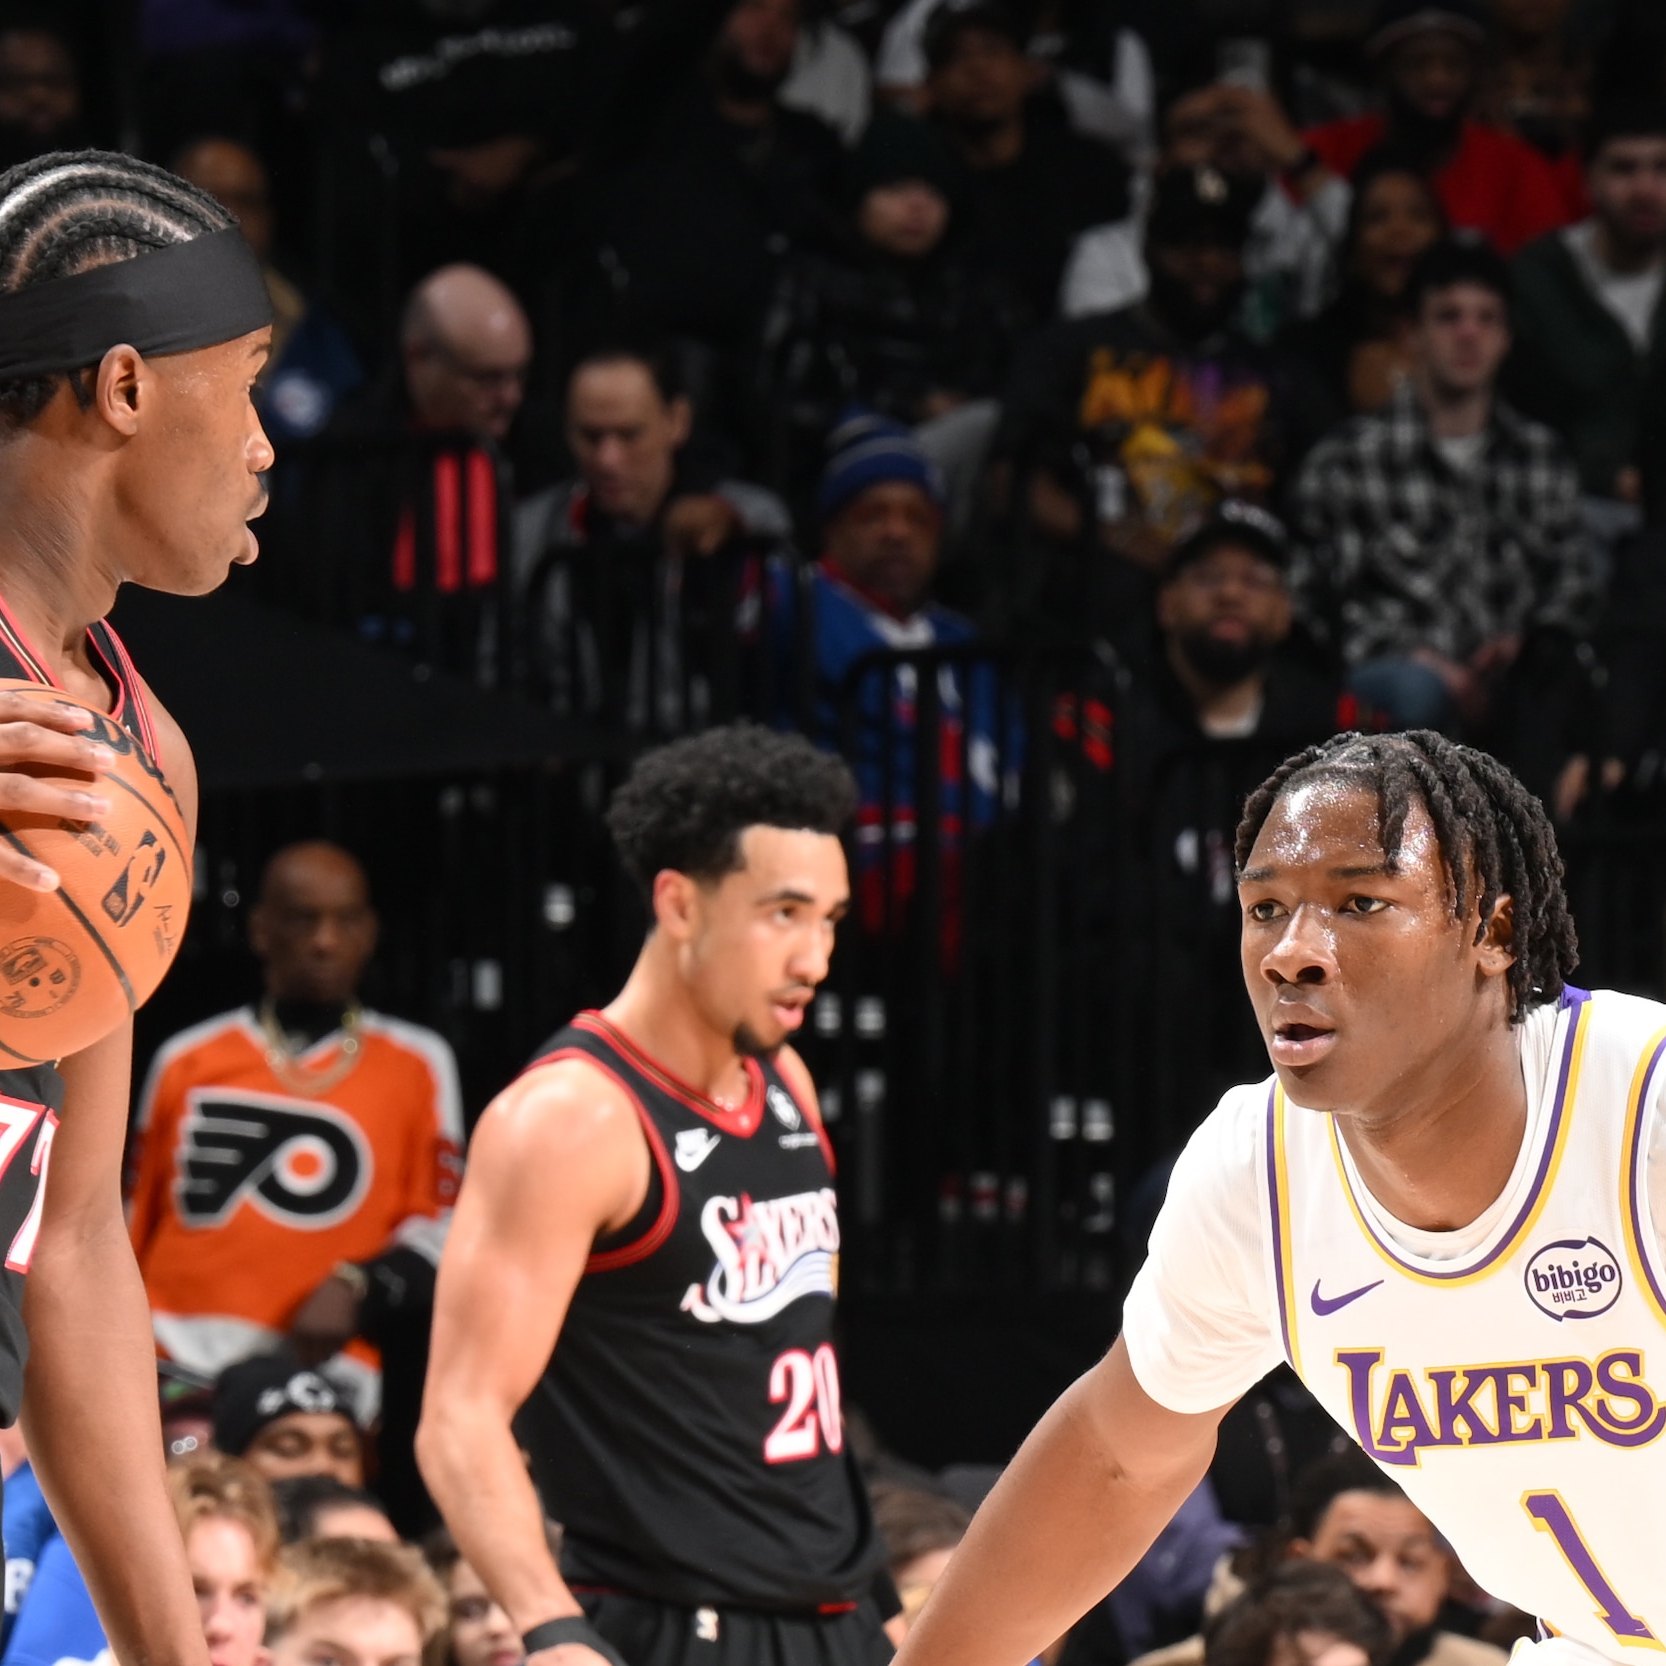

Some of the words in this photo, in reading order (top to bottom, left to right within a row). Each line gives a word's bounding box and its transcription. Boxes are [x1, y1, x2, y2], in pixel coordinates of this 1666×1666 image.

[1532, 1260, 1616, 1293] bibigo
[1551, 1289, 1588, 1304] 비비고
[764, 1342, 843, 1464] 20
